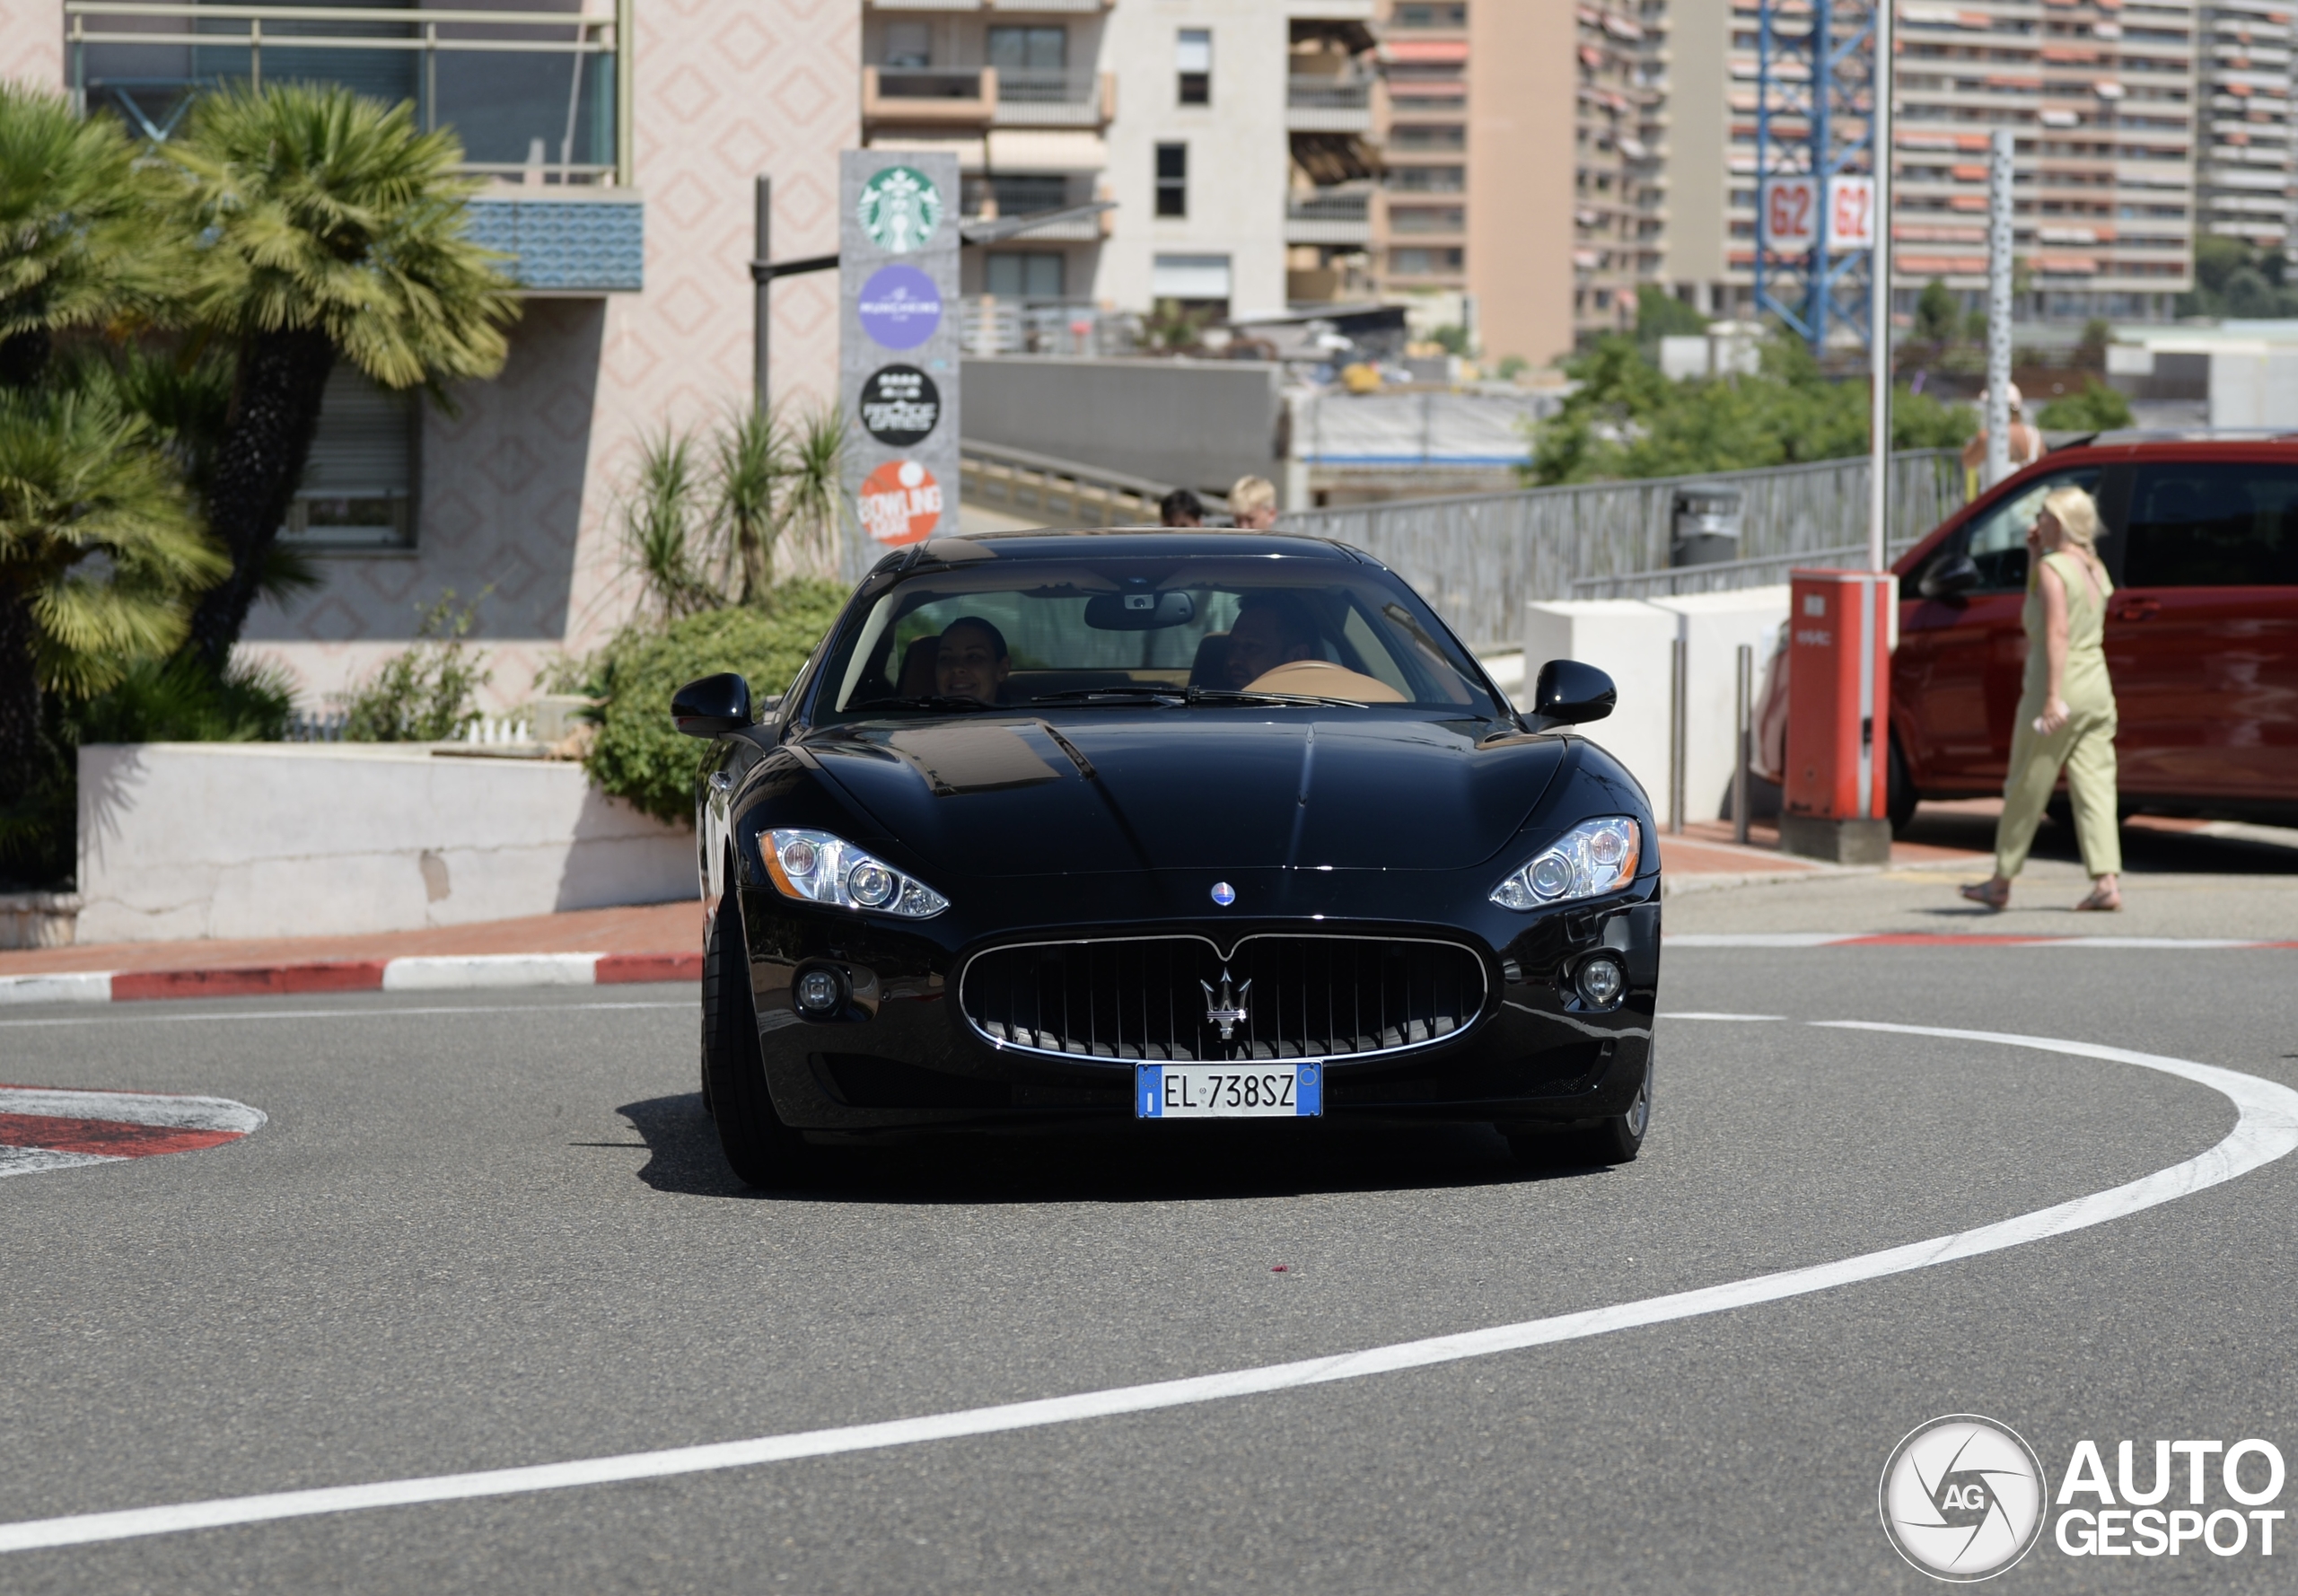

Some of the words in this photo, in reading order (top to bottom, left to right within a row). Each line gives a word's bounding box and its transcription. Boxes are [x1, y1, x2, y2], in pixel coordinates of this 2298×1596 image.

[1770, 185, 1811, 237] 62
[857, 485, 943, 523] BOWLING
[1164, 1074, 1197, 1107] EL
[1208, 1074, 1294, 1108] 738SZ
